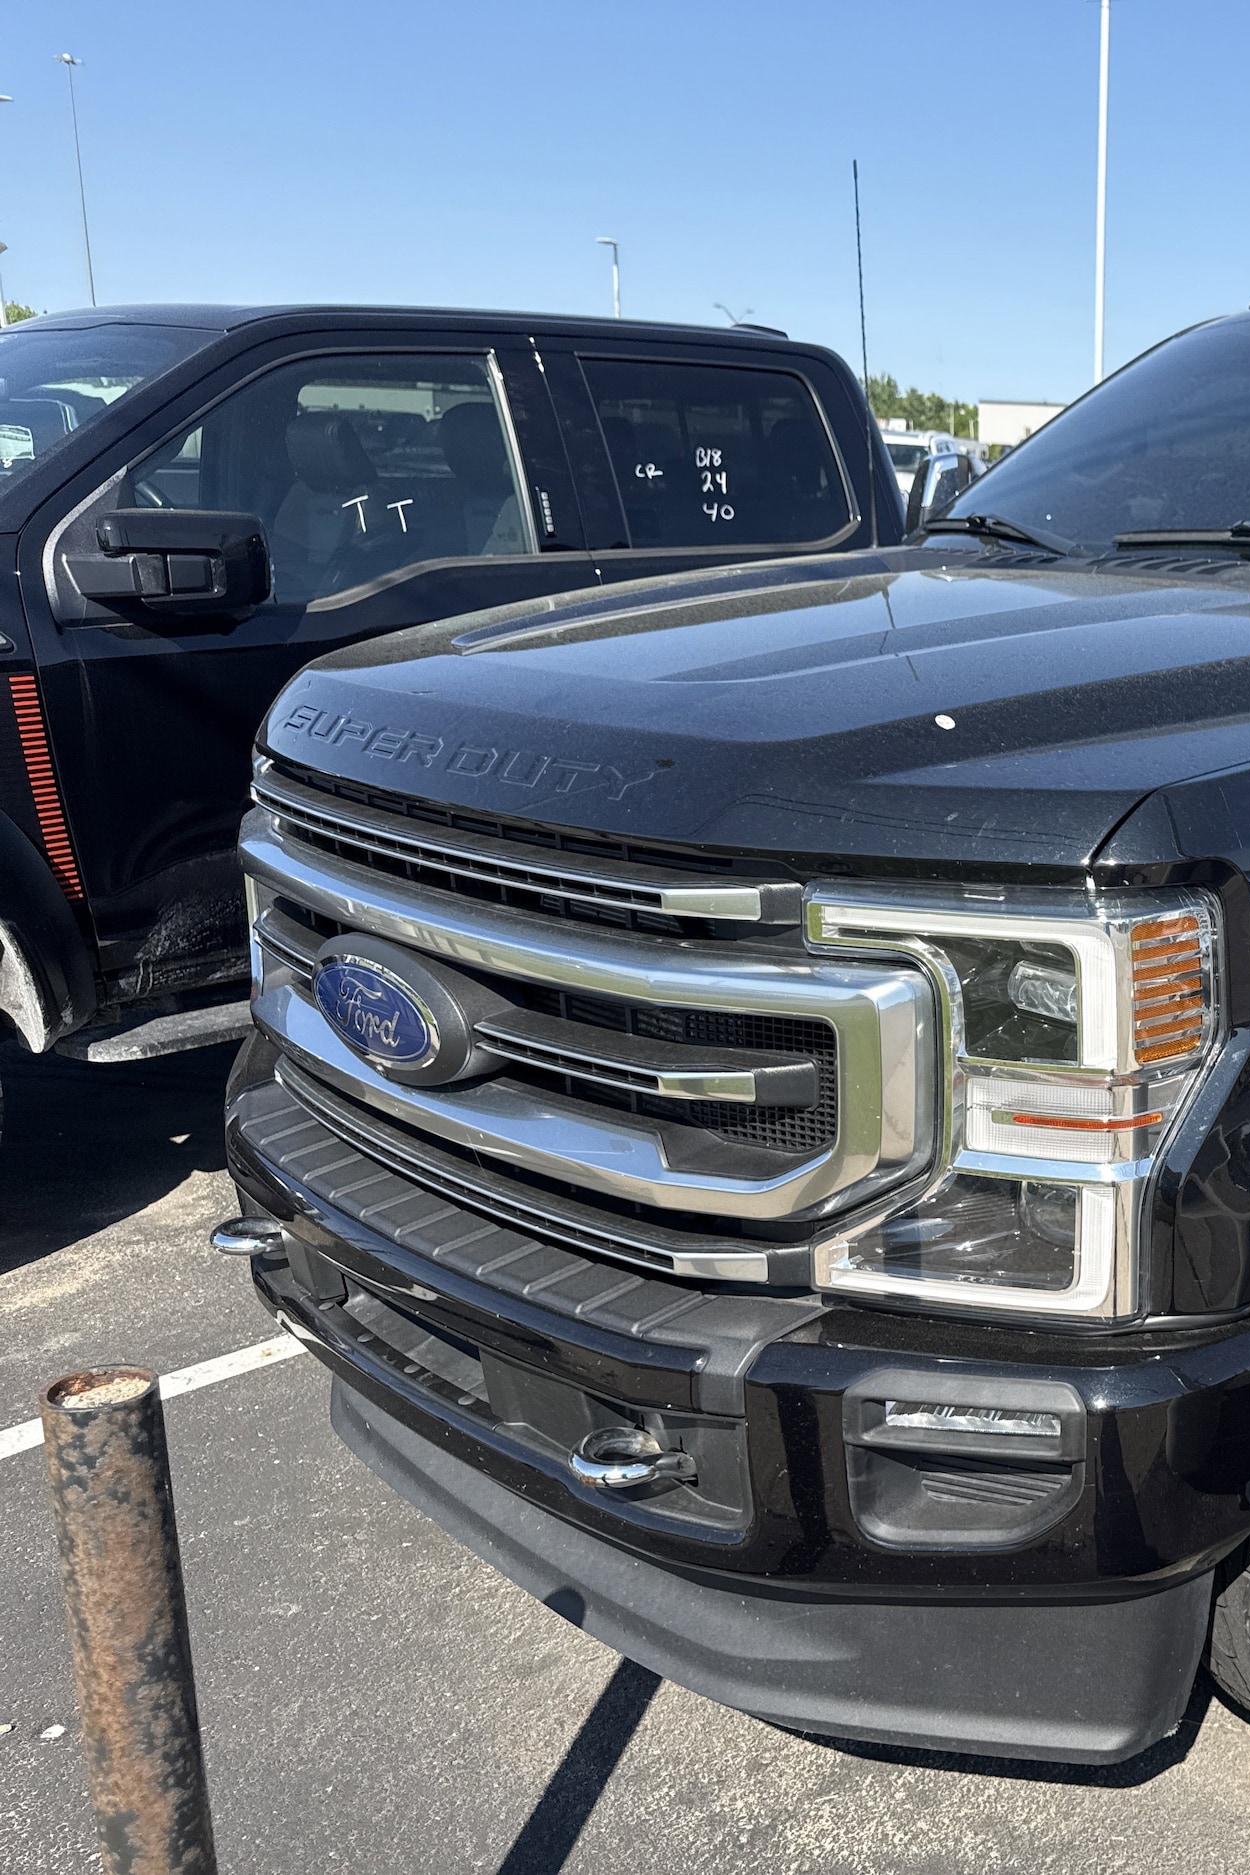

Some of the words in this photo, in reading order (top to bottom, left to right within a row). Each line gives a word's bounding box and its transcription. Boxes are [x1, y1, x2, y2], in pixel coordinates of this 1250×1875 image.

[701, 470, 727, 495] 24
[702, 502, 735, 522] 40
[283, 704, 444, 768] SUPER
[445, 741, 655, 801] DUTY
[336, 972, 401, 1048] Ford
